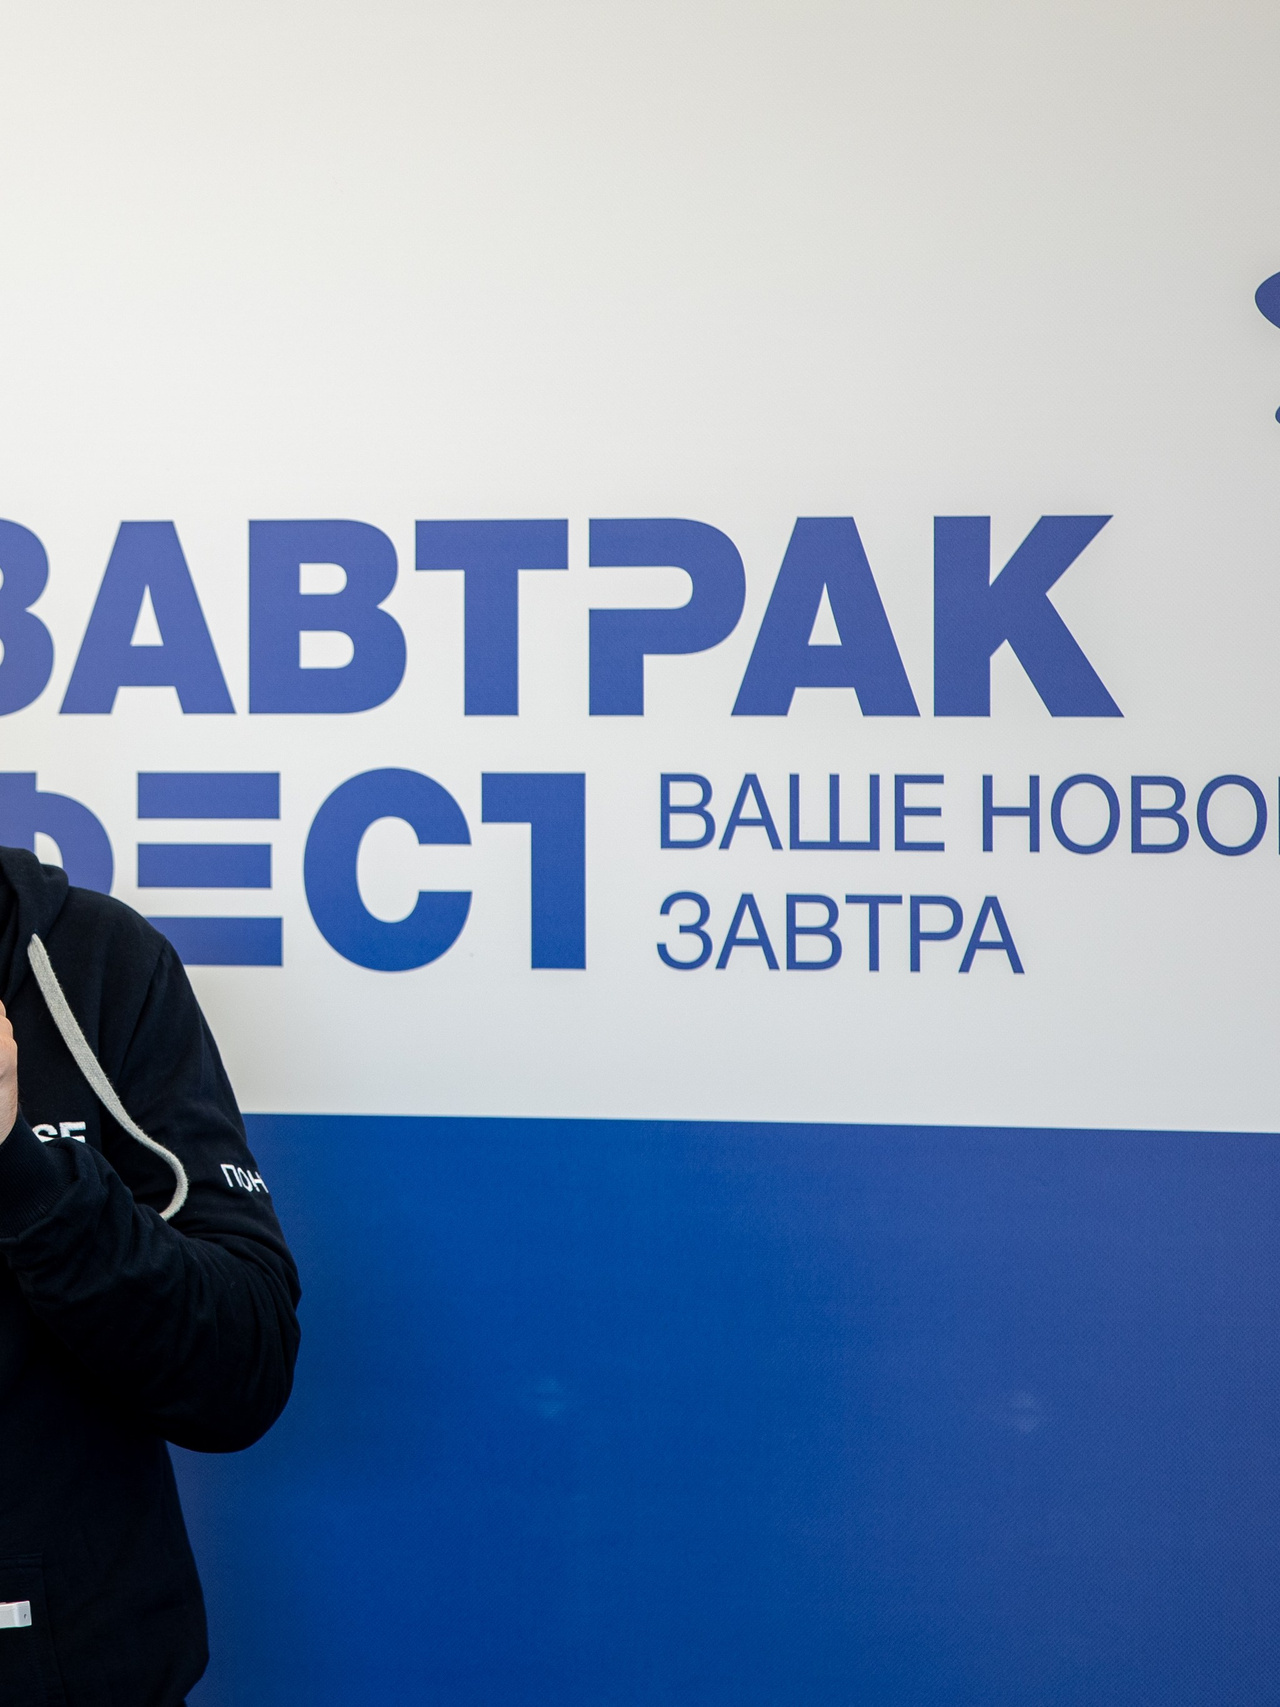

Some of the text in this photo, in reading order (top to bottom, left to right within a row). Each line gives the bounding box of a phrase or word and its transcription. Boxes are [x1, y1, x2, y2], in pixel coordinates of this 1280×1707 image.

[659, 772, 1280, 857] ВАШЕ НОВО
[656, 890, 1025, 974] ЗАВТРА
